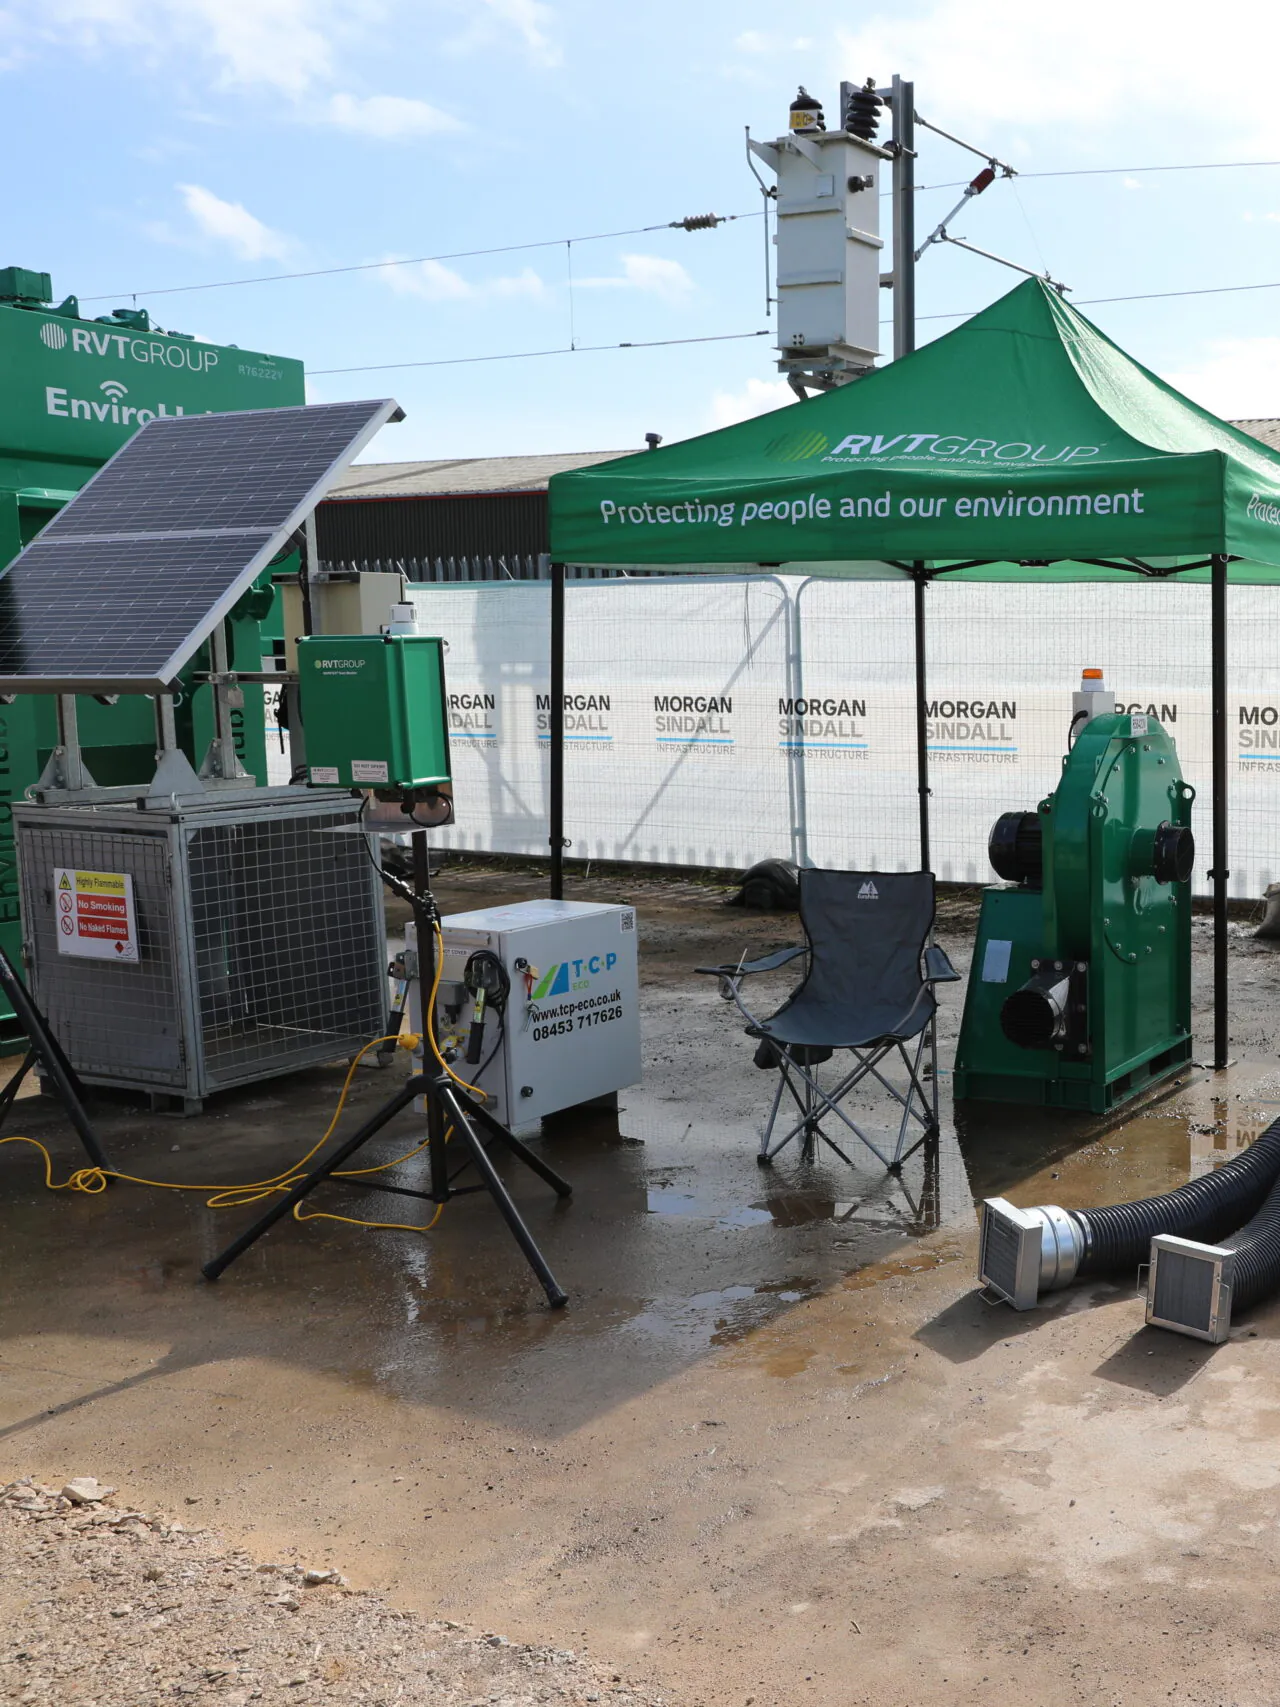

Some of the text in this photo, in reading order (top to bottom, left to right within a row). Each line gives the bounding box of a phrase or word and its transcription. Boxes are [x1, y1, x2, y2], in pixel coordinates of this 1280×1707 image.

[72, 328, 218, 373] RVTGROUP
[831, 434, 1100, 463] RVTGROUP
[821, 455, 887, 466] Protecting
[890, 454, 936, 463] people
[600, 488, 1144, 527] Protecting people and our environment
[322, 659, 366, 669] RVTGROUP
[536, 694, 611, 711] MRGAN
[654, 695, 733, 713] MORGAN
[778, 698, 867, 716] MORGAN
[536, 713, 609, 731] SIDALL
[656, 715, 730, 733] SINDALL
[778, 718, 864, 737] SINDALL
[537, 740, 615, 752] INFSTRUCTURE
[656, 743, 736, 755] INFRASTRUCTURE
[779, 748, 870, 760] INFRASTRUCTURE
[927, 751, 1019, 764] NFRASTRUCTURE
[76, 876, 125, 889] Highly Flammable
[78, 900, 125, 914] No Smoking
[79, 922, 127, 935] No Naked Flames
[572, 980, 590, 991] ECO
[531, 989, 622, 1024] www.tcp-eco.co.uk
[533, 1005, 623, 1042] 08453 717626
